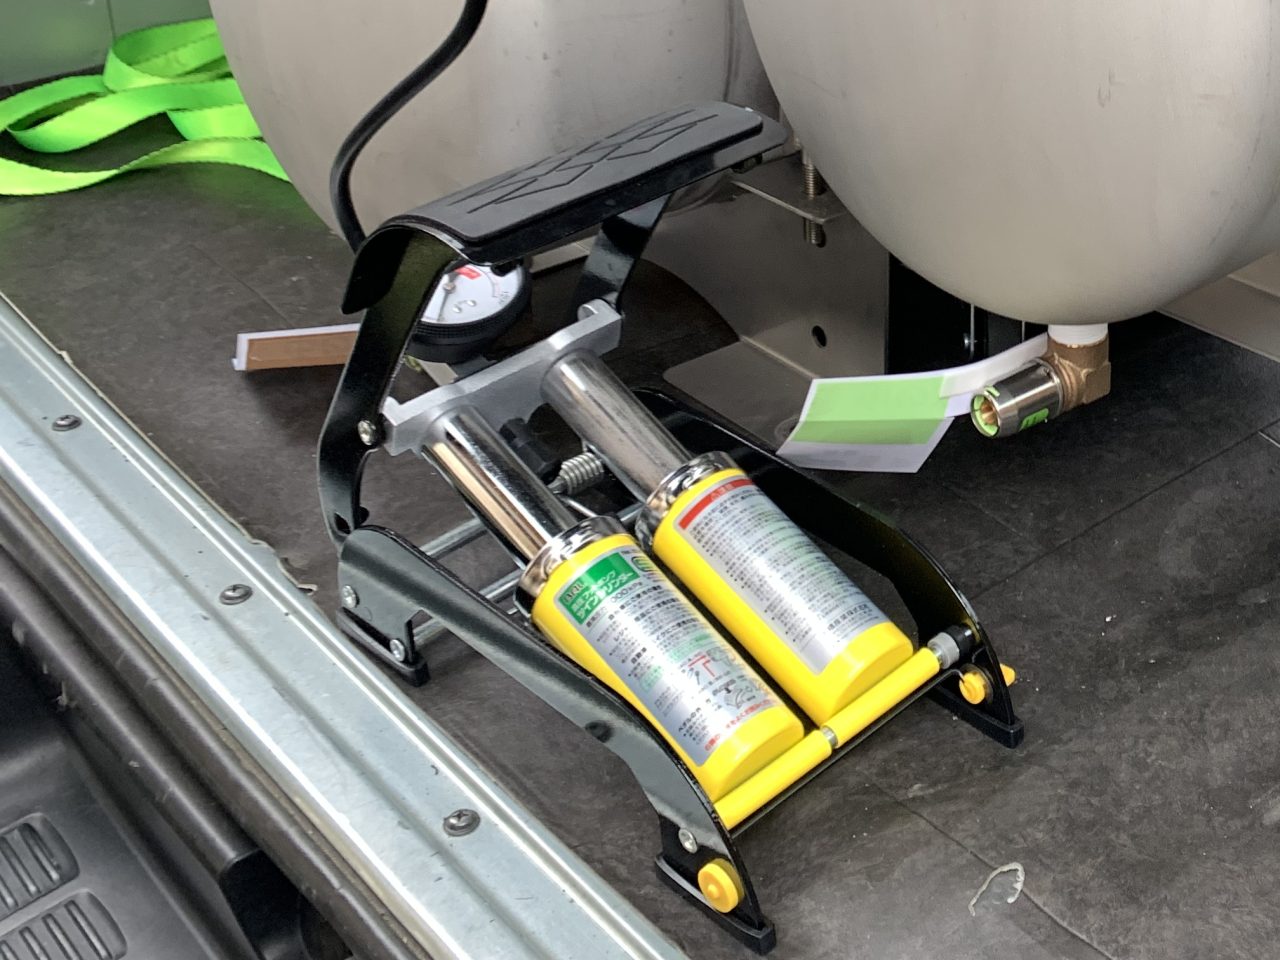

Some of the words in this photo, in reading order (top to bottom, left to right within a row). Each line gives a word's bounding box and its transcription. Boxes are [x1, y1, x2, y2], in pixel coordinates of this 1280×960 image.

[577, 572, 634, 619] ツインリンダー
